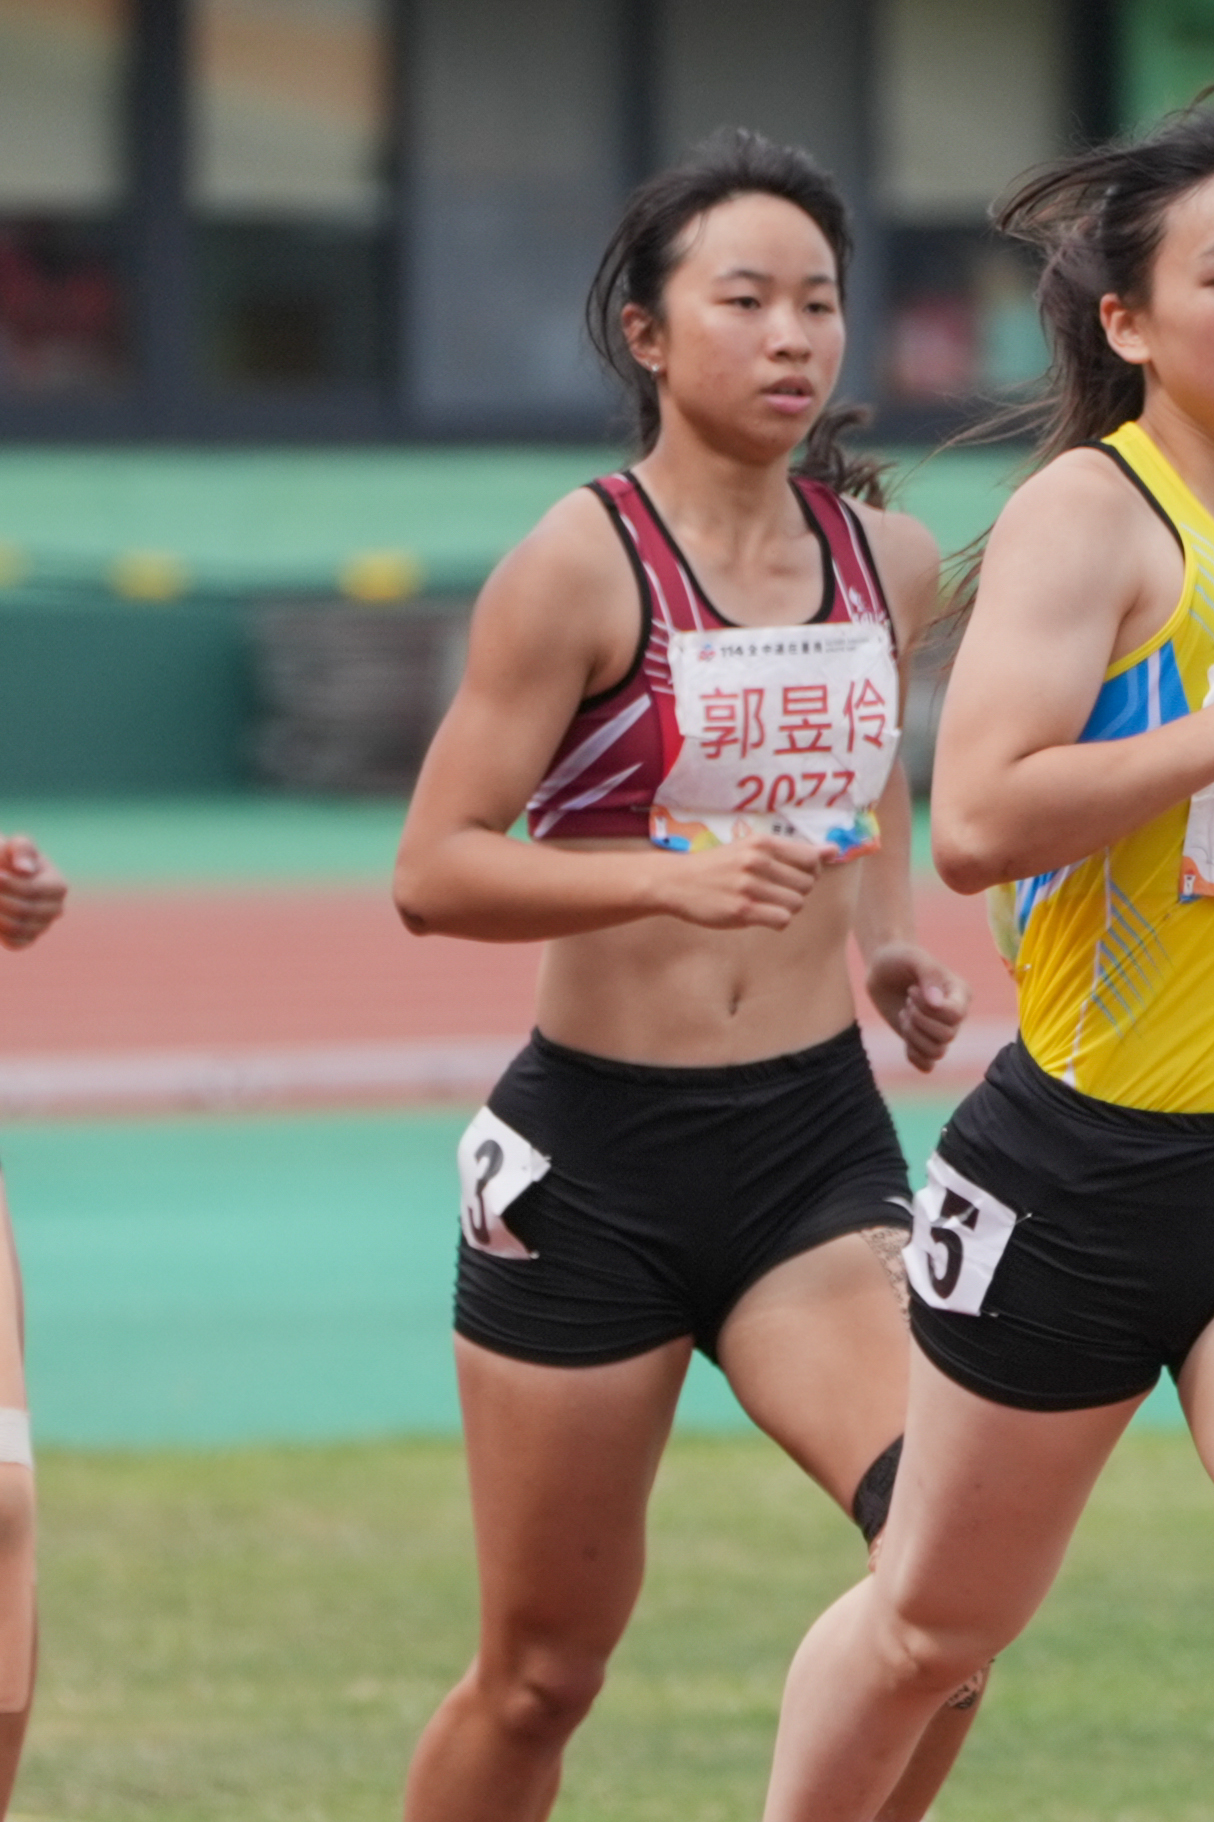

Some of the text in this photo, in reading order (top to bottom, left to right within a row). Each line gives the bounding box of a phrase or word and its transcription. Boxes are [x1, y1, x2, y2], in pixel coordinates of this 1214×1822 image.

[699, 678, 887, 760] 郭昱伶
[732, 769, 856, 813] 2077
[468, 1139, 504, 1245] 3
[926, 1187, 981, 1300] 5
